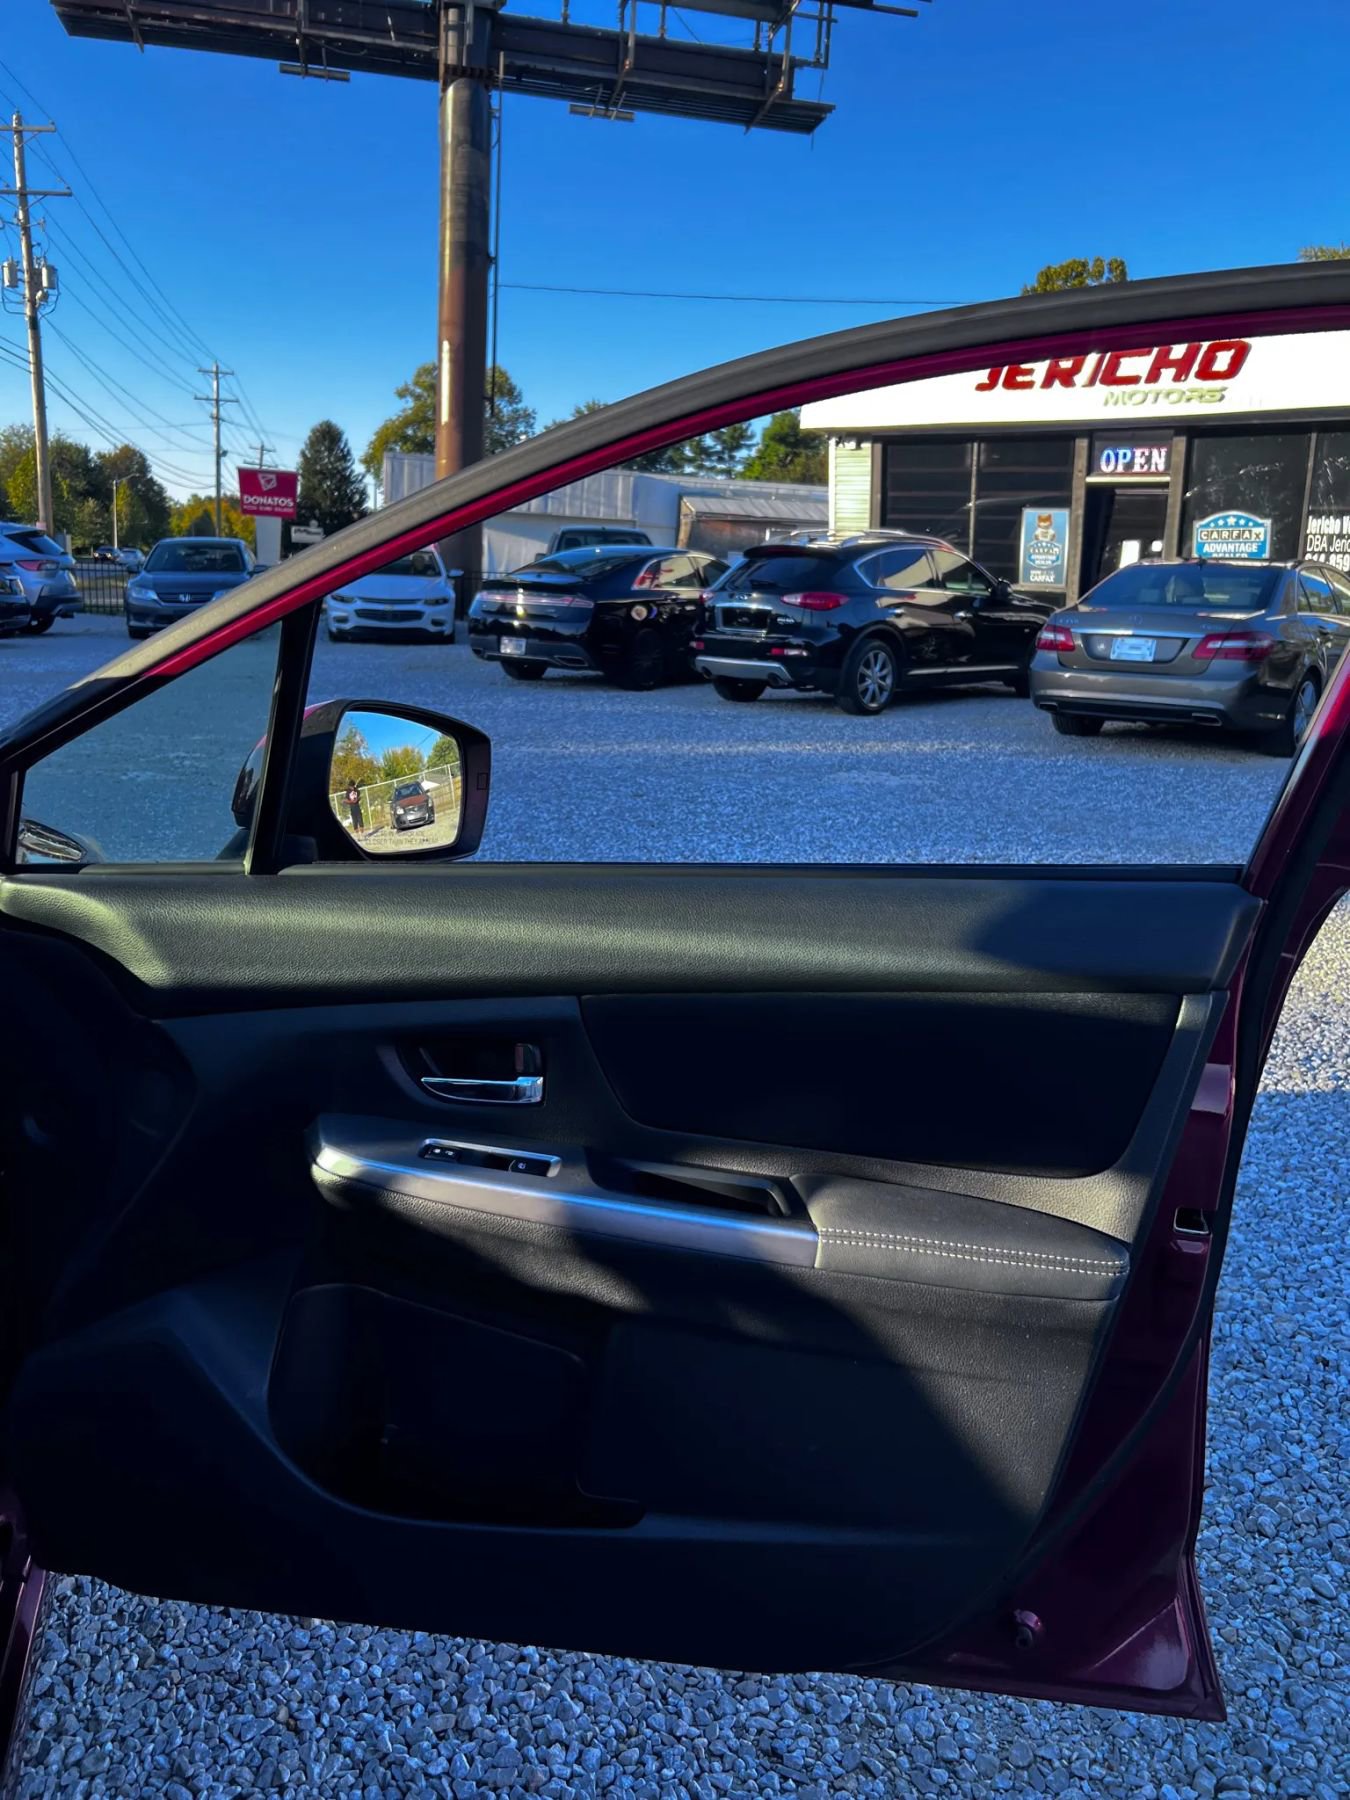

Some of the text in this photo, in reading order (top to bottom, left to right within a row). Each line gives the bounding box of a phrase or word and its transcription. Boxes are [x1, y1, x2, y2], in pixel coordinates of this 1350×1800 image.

[975, 339, 1251, 392] JERICHO
[1103, 386, 1228, 406] MOTORS
[1100, 447, 1168, 473] OPEN
[243, 495, 294, 507] DONATOS
[1306, 515, 1341, 534] Jericho
[1200, 529, 1263, 541] CARFAX
[1306, 535, 1328, 552] DBA
[1203, 542, 1259, 553] ADVANTAGE
